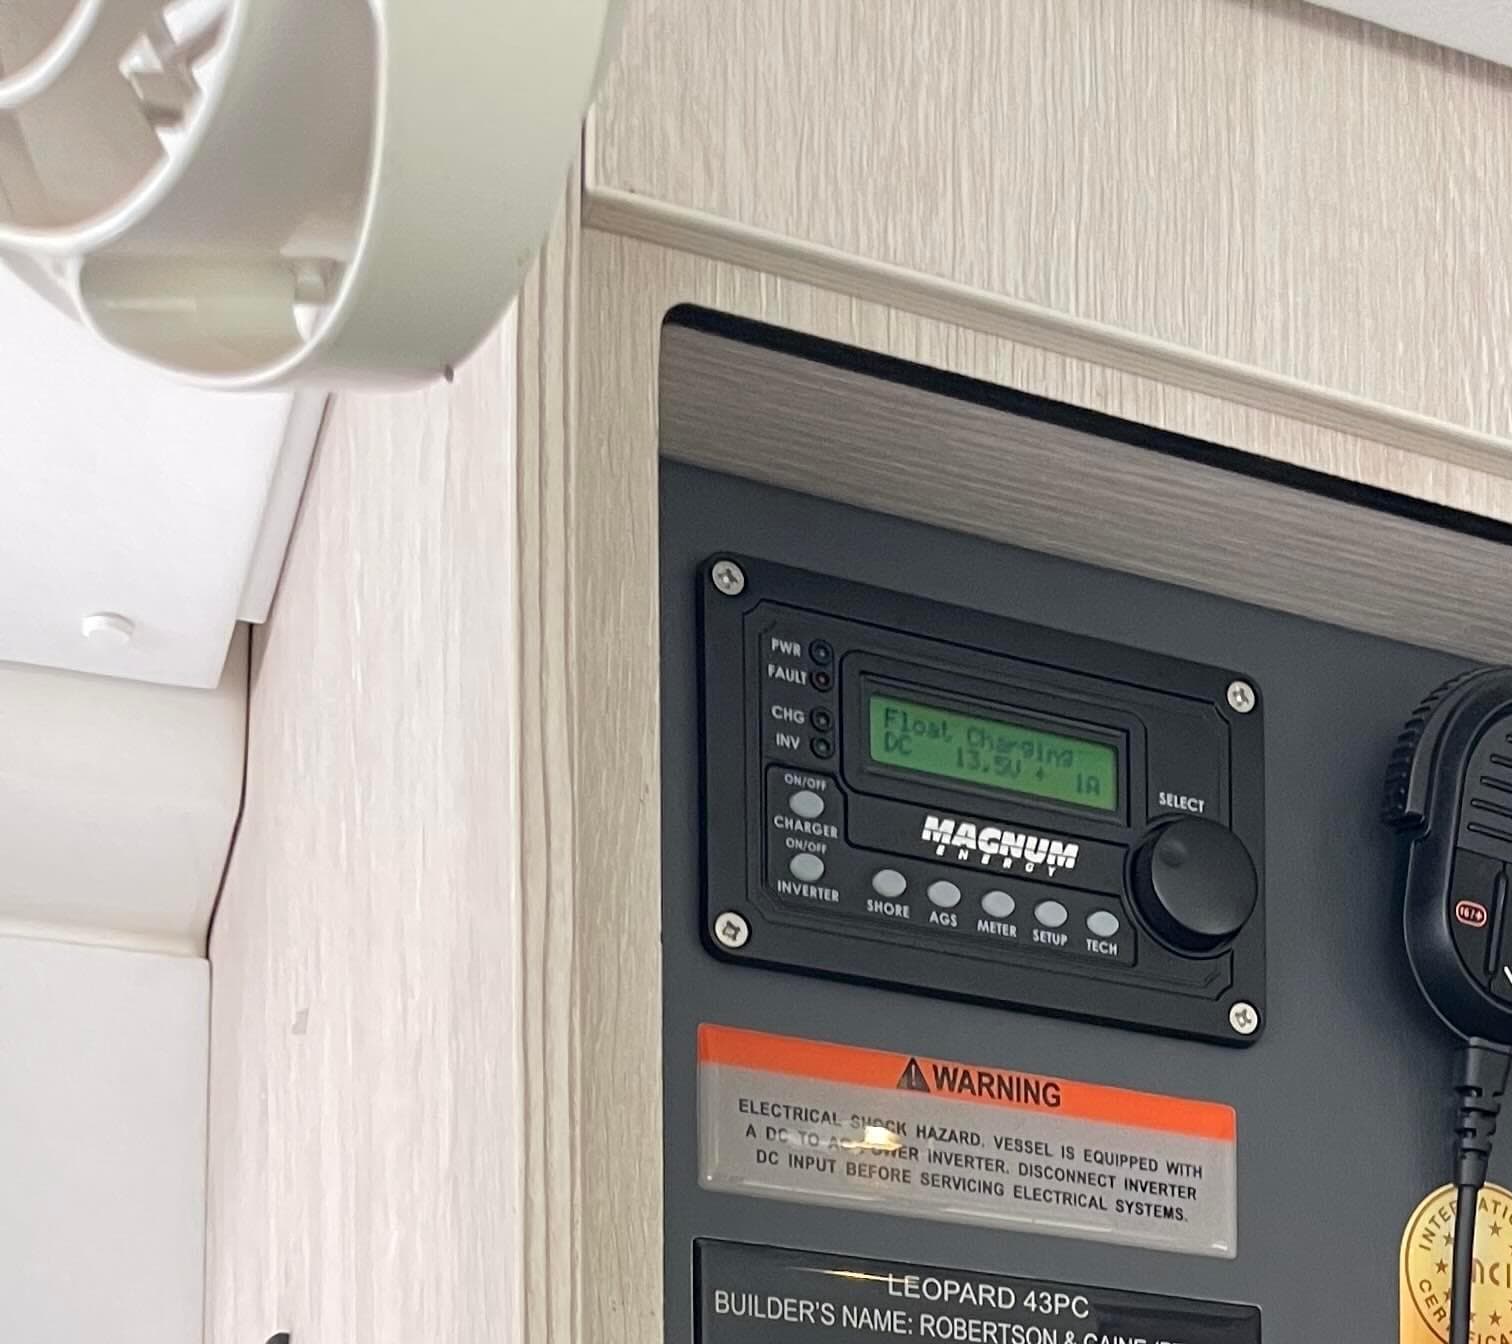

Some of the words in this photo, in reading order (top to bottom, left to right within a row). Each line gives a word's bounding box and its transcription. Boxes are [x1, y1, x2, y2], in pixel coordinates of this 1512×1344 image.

[771, 638, 801, 656] PWR
[768, 665, 806, 684] FAULT
[772, 706, 805, 724] CHG
[776, 734, 800, 749] INV
[784, 773, 826, 790] ON/OFF
[1160, 792, 1205, 812] SELECT
[774, 816, 838, 838] CHARGER
[785, 838, 827, 854] ON/OFF
[922, 816, 1079, 869] MAGNUM
[936, 846, 1057, 878] ENERGY
[778, 881, 840, 902] INVERTER
[867, 900, 909, 919] SHORE
[930, 912, 958, 927] AGS
[977, 919, 1017, 938] METER
[1033, 929, 1067, 946] SETUP
[1087, 939, 1118, 955] TECH
[932, 1064, 1061, 1108] WARNING
[739, 1099, 842, 1126] ELECTRICAL
[916, 1124, 985, 1147] HAZARD.
[994, 1135, 1053, 1158] VESSEL
[1061, 1145, 1075, 1160] IS
[1084, 1148, 1161, 1172] EQUIPPED
[1168, 1160, 1202, 1179] WITH
[746, 1124, 756, 1138] A
[766, 1126, 787, 1143] DC
[799, 1131, 821, 1147] TO
[928, 1149, 1010, 1175] INVERTER.
[1018, 1162, 1115, 1189] DISCONNECT
[1124, 1175, 1197, 1200] INVERTER
[756, 1149, 779, 1165] DC
[788, 1153, 836, 1174] INPUT
[846, 1162, 912, 1184] BEFORE
[920, 1174, 1004, 1197] SERVICING
[1013, 1185, 1108, 1210] ELECTRICAL
[1115, 1199, 1188, 1221] SYSTEMS.
[888, 1273, 1015, 1310] LEOPARD
[1024, 1291, 1089, 1318] 43PC
[715, 1291, 835, 1325] BUILDER'S
[842, 1309, 913, 1335] NAME:
